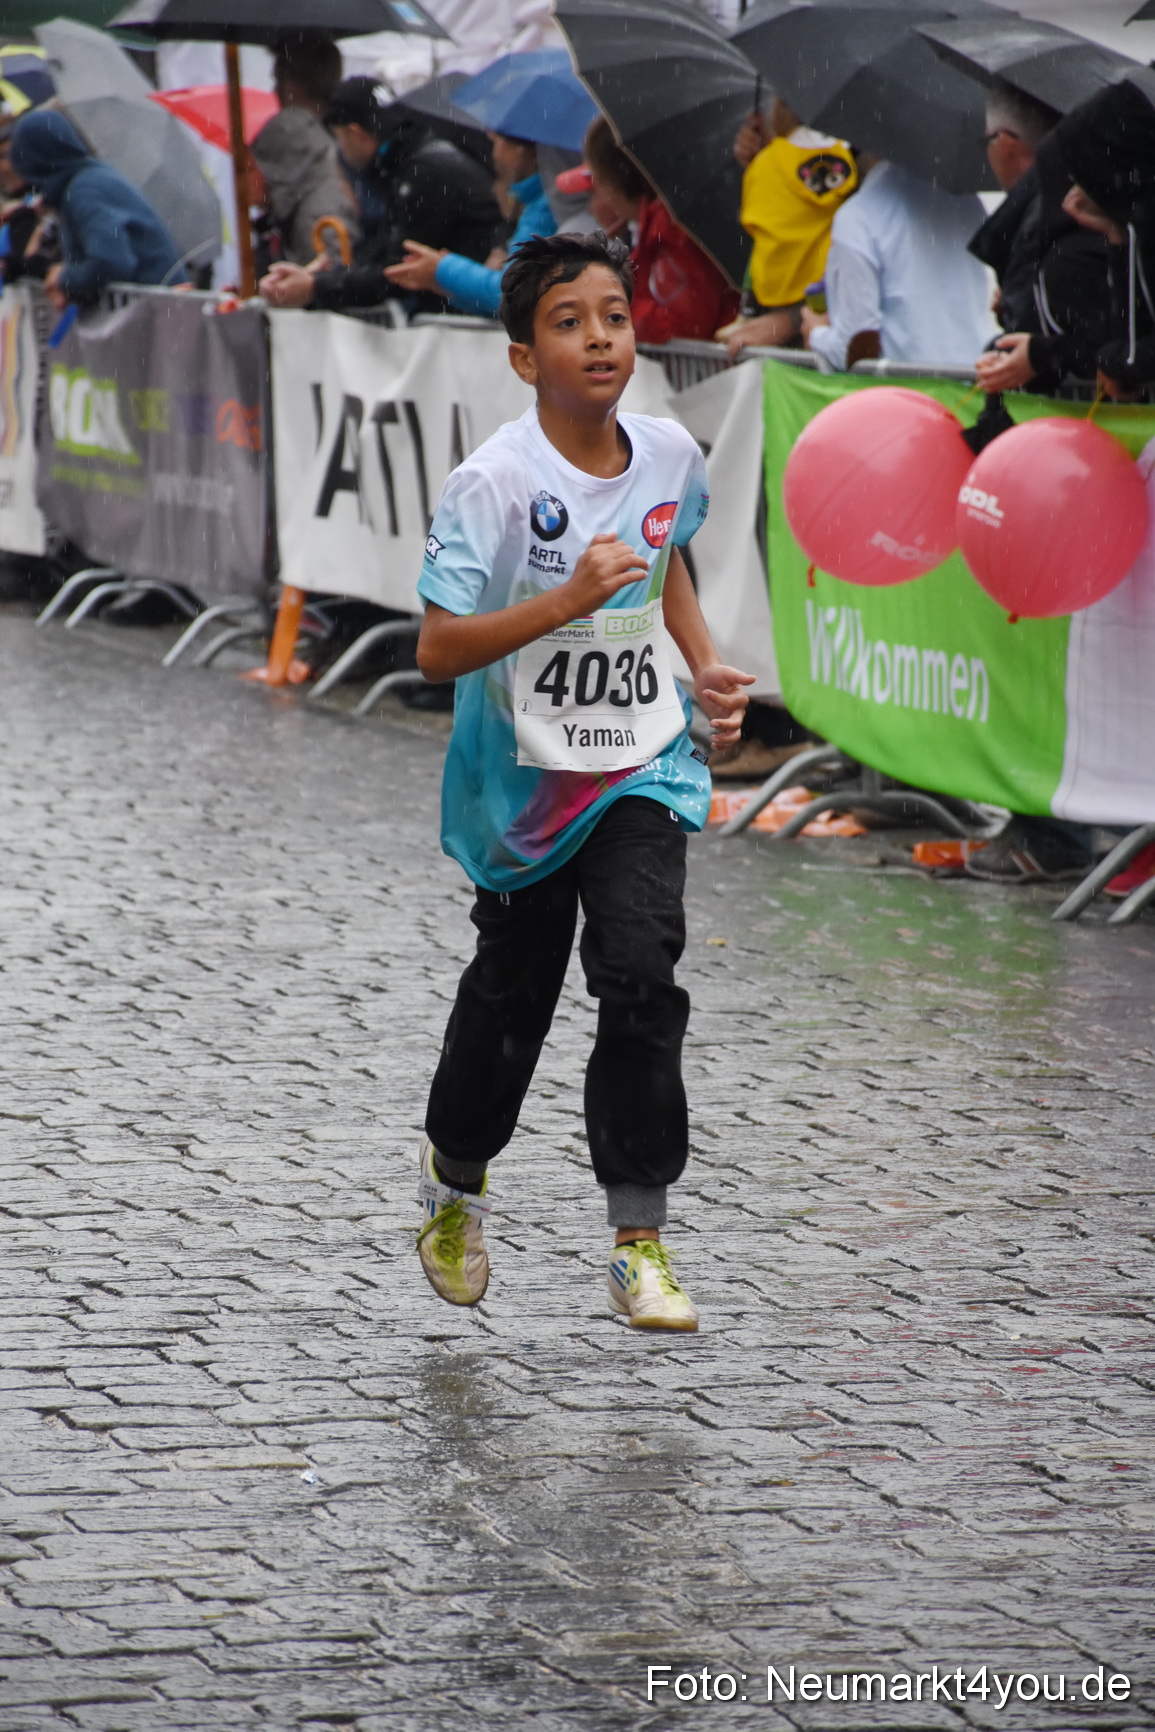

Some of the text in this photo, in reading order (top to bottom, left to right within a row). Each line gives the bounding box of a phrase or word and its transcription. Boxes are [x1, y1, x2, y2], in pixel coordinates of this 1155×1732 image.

[534, 490, 564, 511] BMW
[529, 545, 567, 565] ARTL
[806, 599, 990, 723] Willkommen
[534, 643, 659, 707] 4036
[562, 723, 637, 748] Yaman
